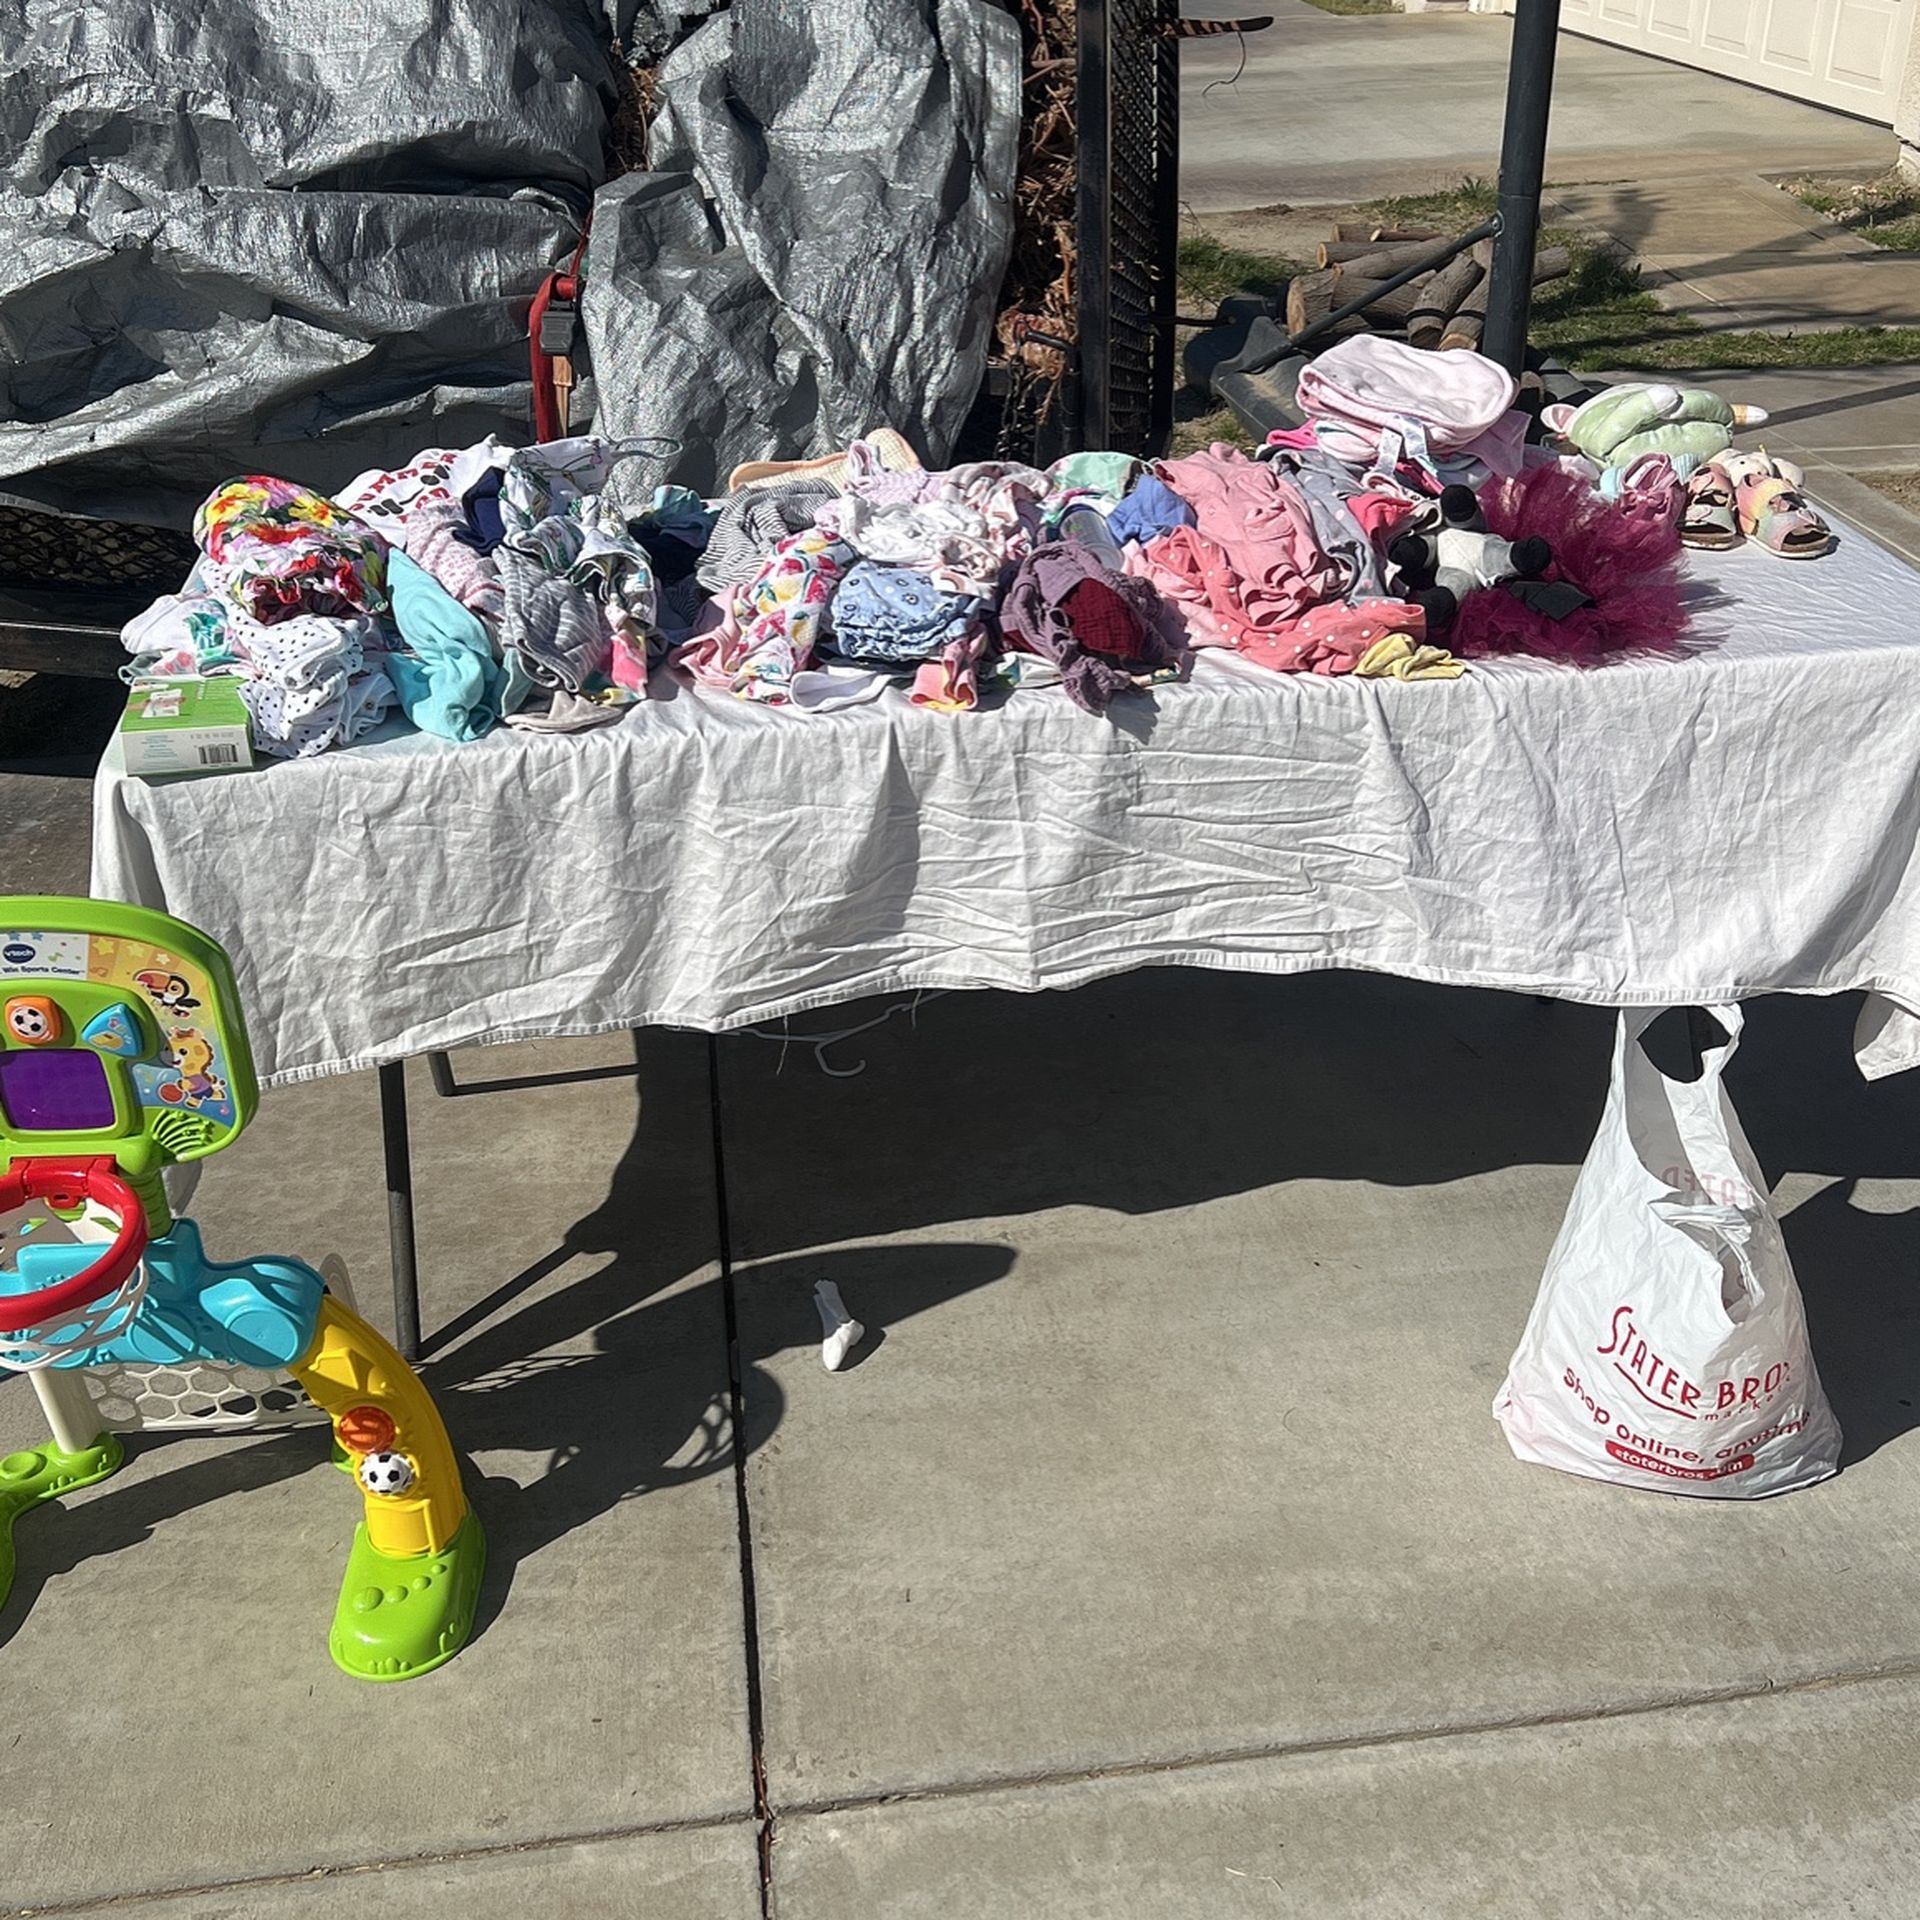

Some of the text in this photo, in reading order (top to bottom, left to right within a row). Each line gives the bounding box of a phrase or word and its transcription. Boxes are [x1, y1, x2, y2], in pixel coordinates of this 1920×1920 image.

[21, 965, 49, 974] Sports
[1597, 1305, 1701, 1410] STATER
[1563, 1367, 1610, 1426] Shop
[1616, 1423, 1704, 1465] online,
